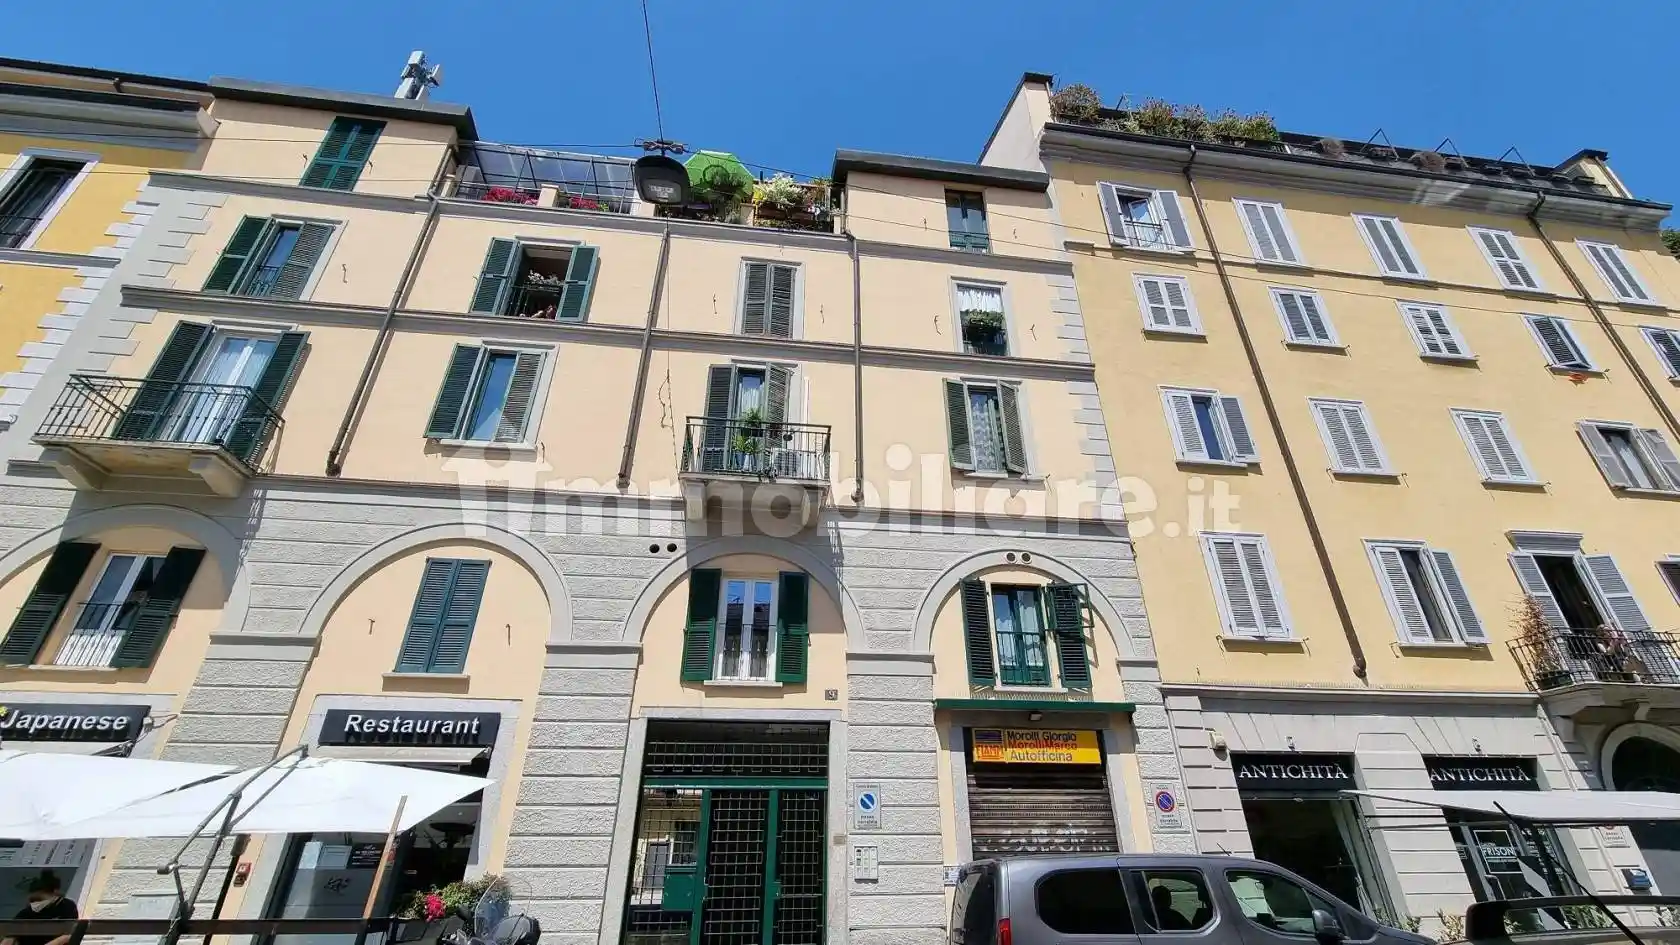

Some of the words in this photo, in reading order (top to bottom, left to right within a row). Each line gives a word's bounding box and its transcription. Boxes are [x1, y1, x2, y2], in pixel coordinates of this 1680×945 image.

[1, 710, 128, 733] Japanese
[344, 714, 480, 734] Restaurant
[1010, 750, 1073, 762] Autofficina
[1239, 762, 1349, 779] ANTICHITÀ
[1430, 765, 1531, 781] ANTICHITÀ
